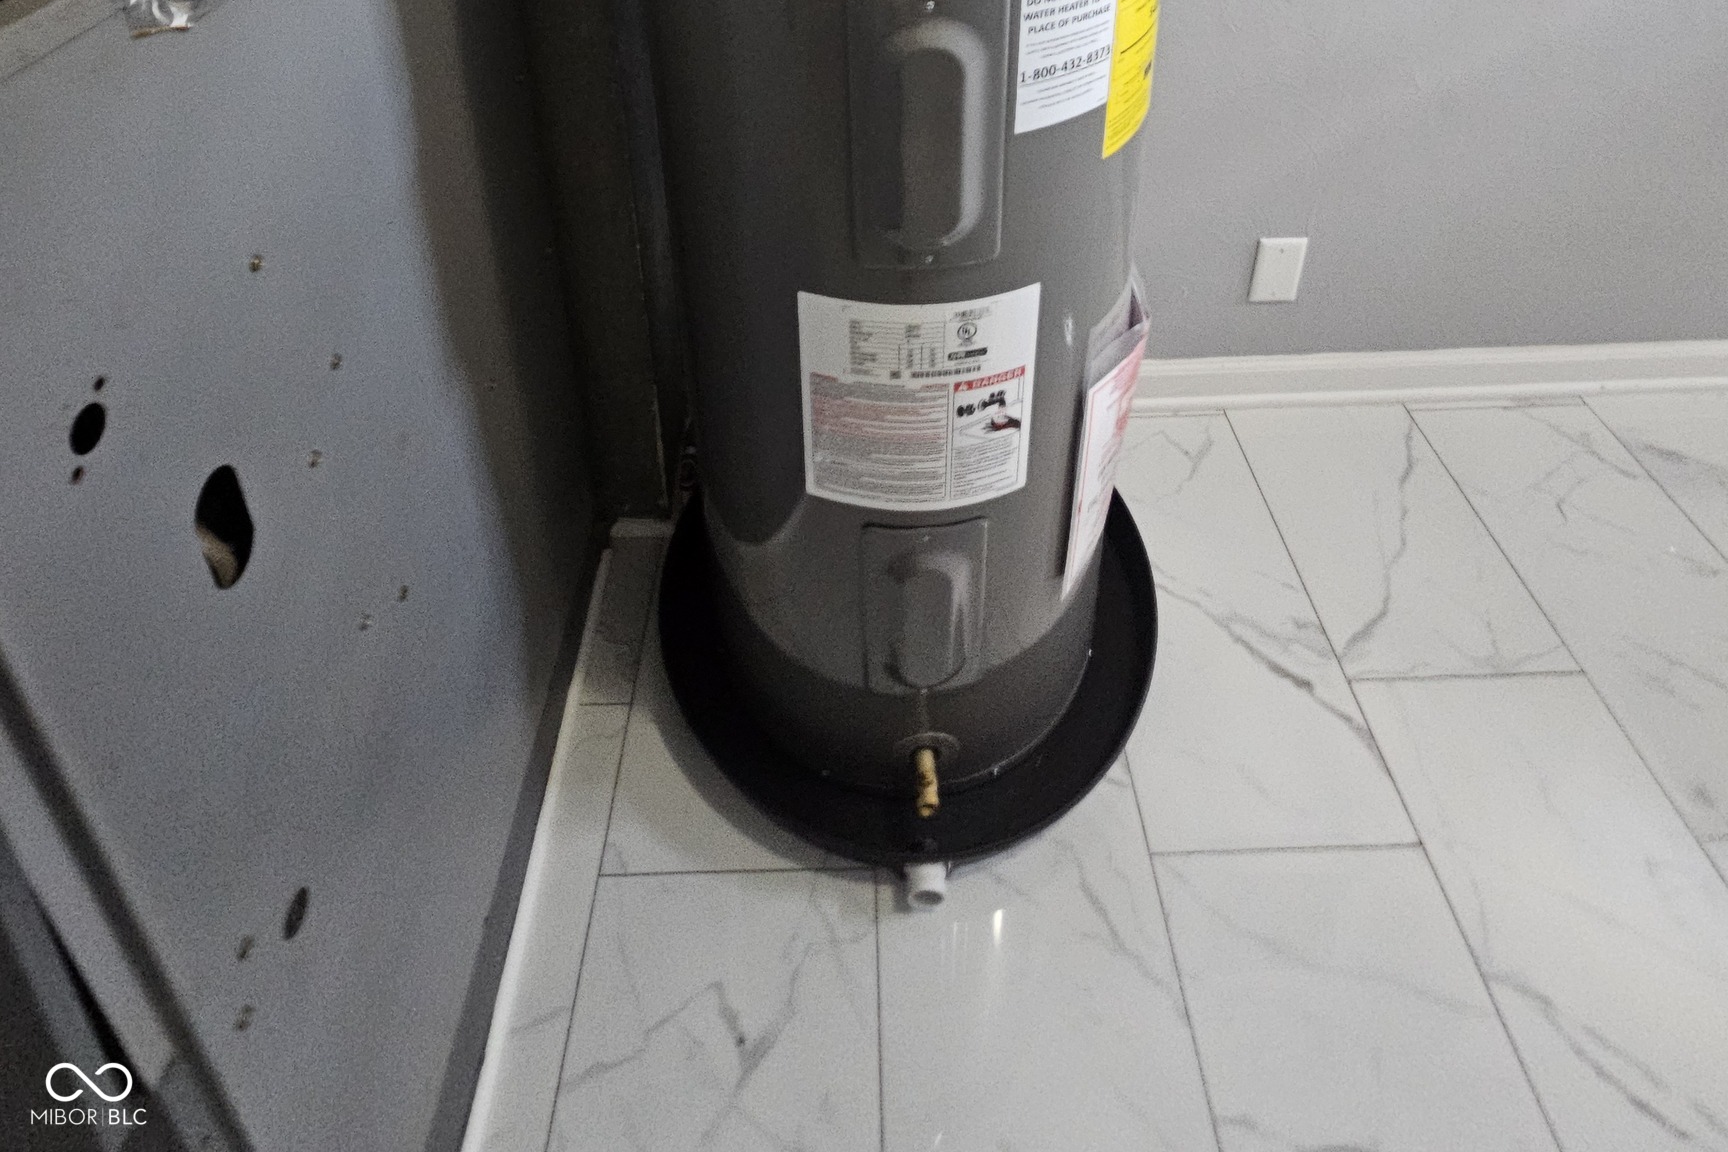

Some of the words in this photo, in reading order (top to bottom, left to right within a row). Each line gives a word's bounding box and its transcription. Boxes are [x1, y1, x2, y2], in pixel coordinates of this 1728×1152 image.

[1023, 7, 1056, 22] WATER
[1027, 22, 1056, 35] PLACE
[1058, 17, 1070, 28] OF
[1071, 3, 1111, 24] PURCHASE
[1021, 44, 1111, 83] 1-800-432-8373
